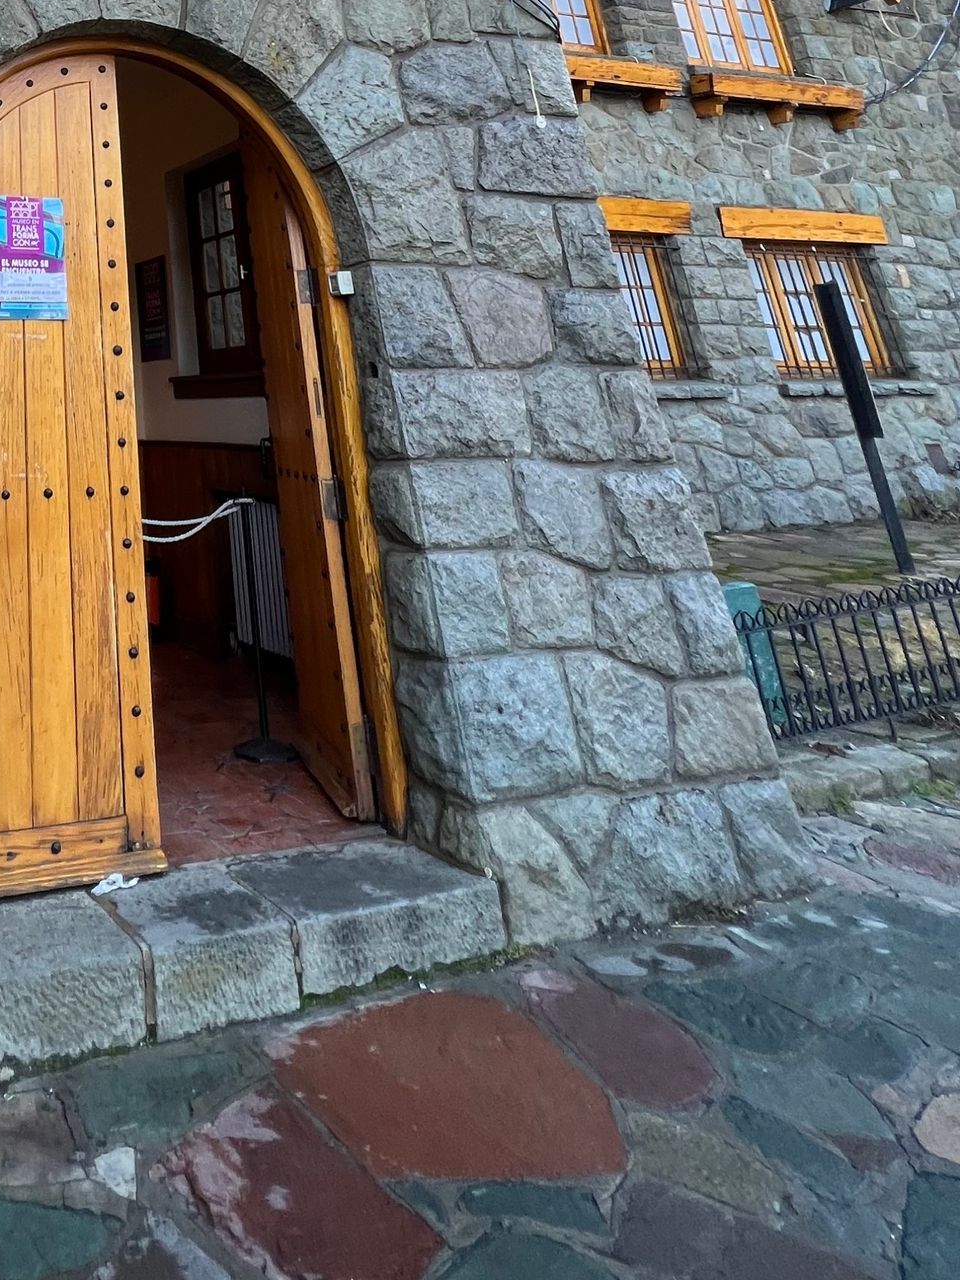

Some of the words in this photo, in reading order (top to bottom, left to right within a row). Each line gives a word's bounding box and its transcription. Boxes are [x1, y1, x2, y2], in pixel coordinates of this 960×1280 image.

[12, 224, 37, 232] TRANS
[12, 231, 39, 239] FORMA
[1, 259, 10, 267] EL
[12, 259, 39, 268] MUSEO
[40, 260, 48, 268] SE
